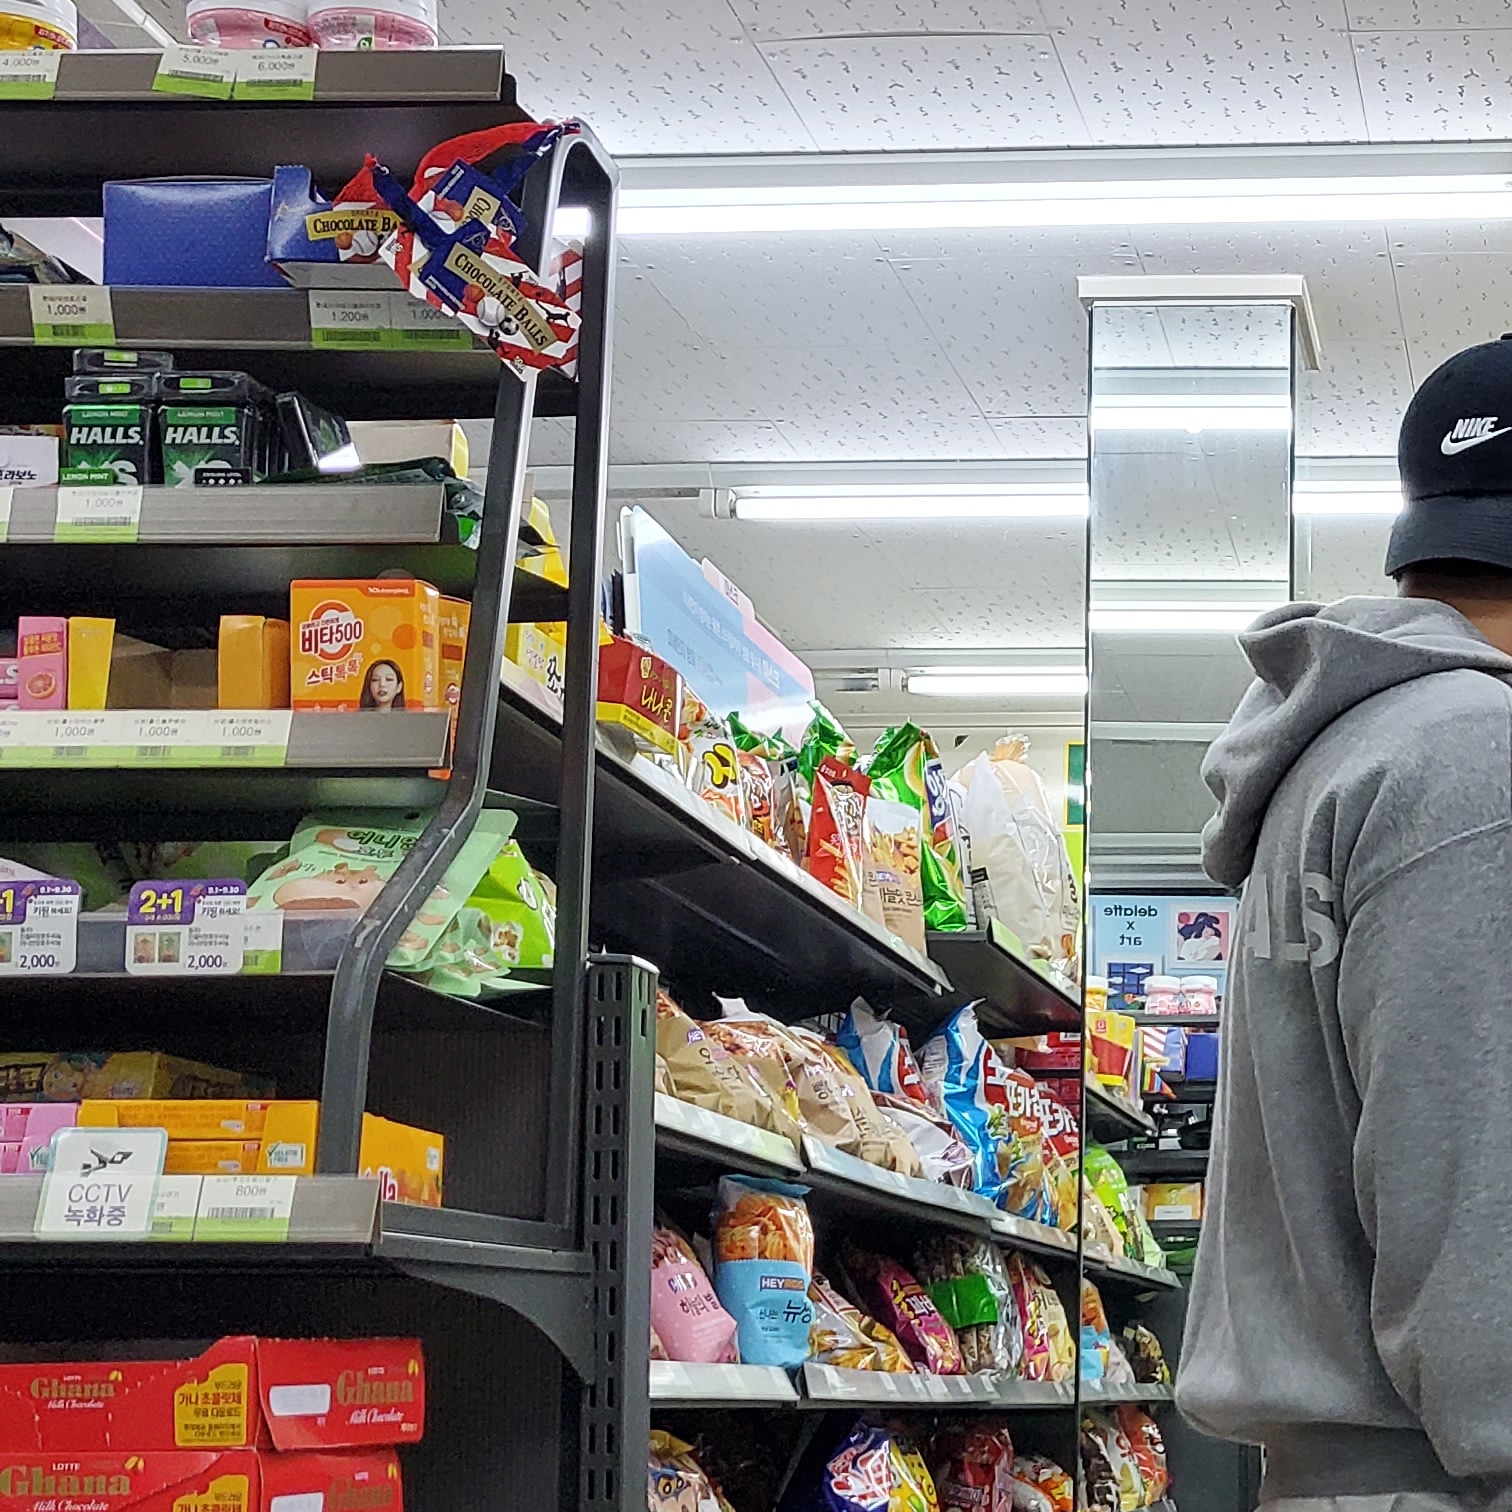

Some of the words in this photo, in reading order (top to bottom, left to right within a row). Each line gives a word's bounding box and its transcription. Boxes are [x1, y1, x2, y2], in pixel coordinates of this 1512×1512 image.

[313, 216, 378, 232] CHOCOLATE
[454, 253, 518, 313] CHOCOLATE
[513, 307, 549, 347] BALLS
[1451, 416, 1498, 439] NIKE
[300, 620, 363, 654] 비타500
[139, 889, 183, 913] 2+1
[67, 1183, 133, 1203] CCTV
[64, 1206, 127, 1227] 녹화중
[31, 1378, 115, 1399] Ghana
[336, 1371, 414, 1405] Ghana
[1, 1466, 131, 1496] Ghana
